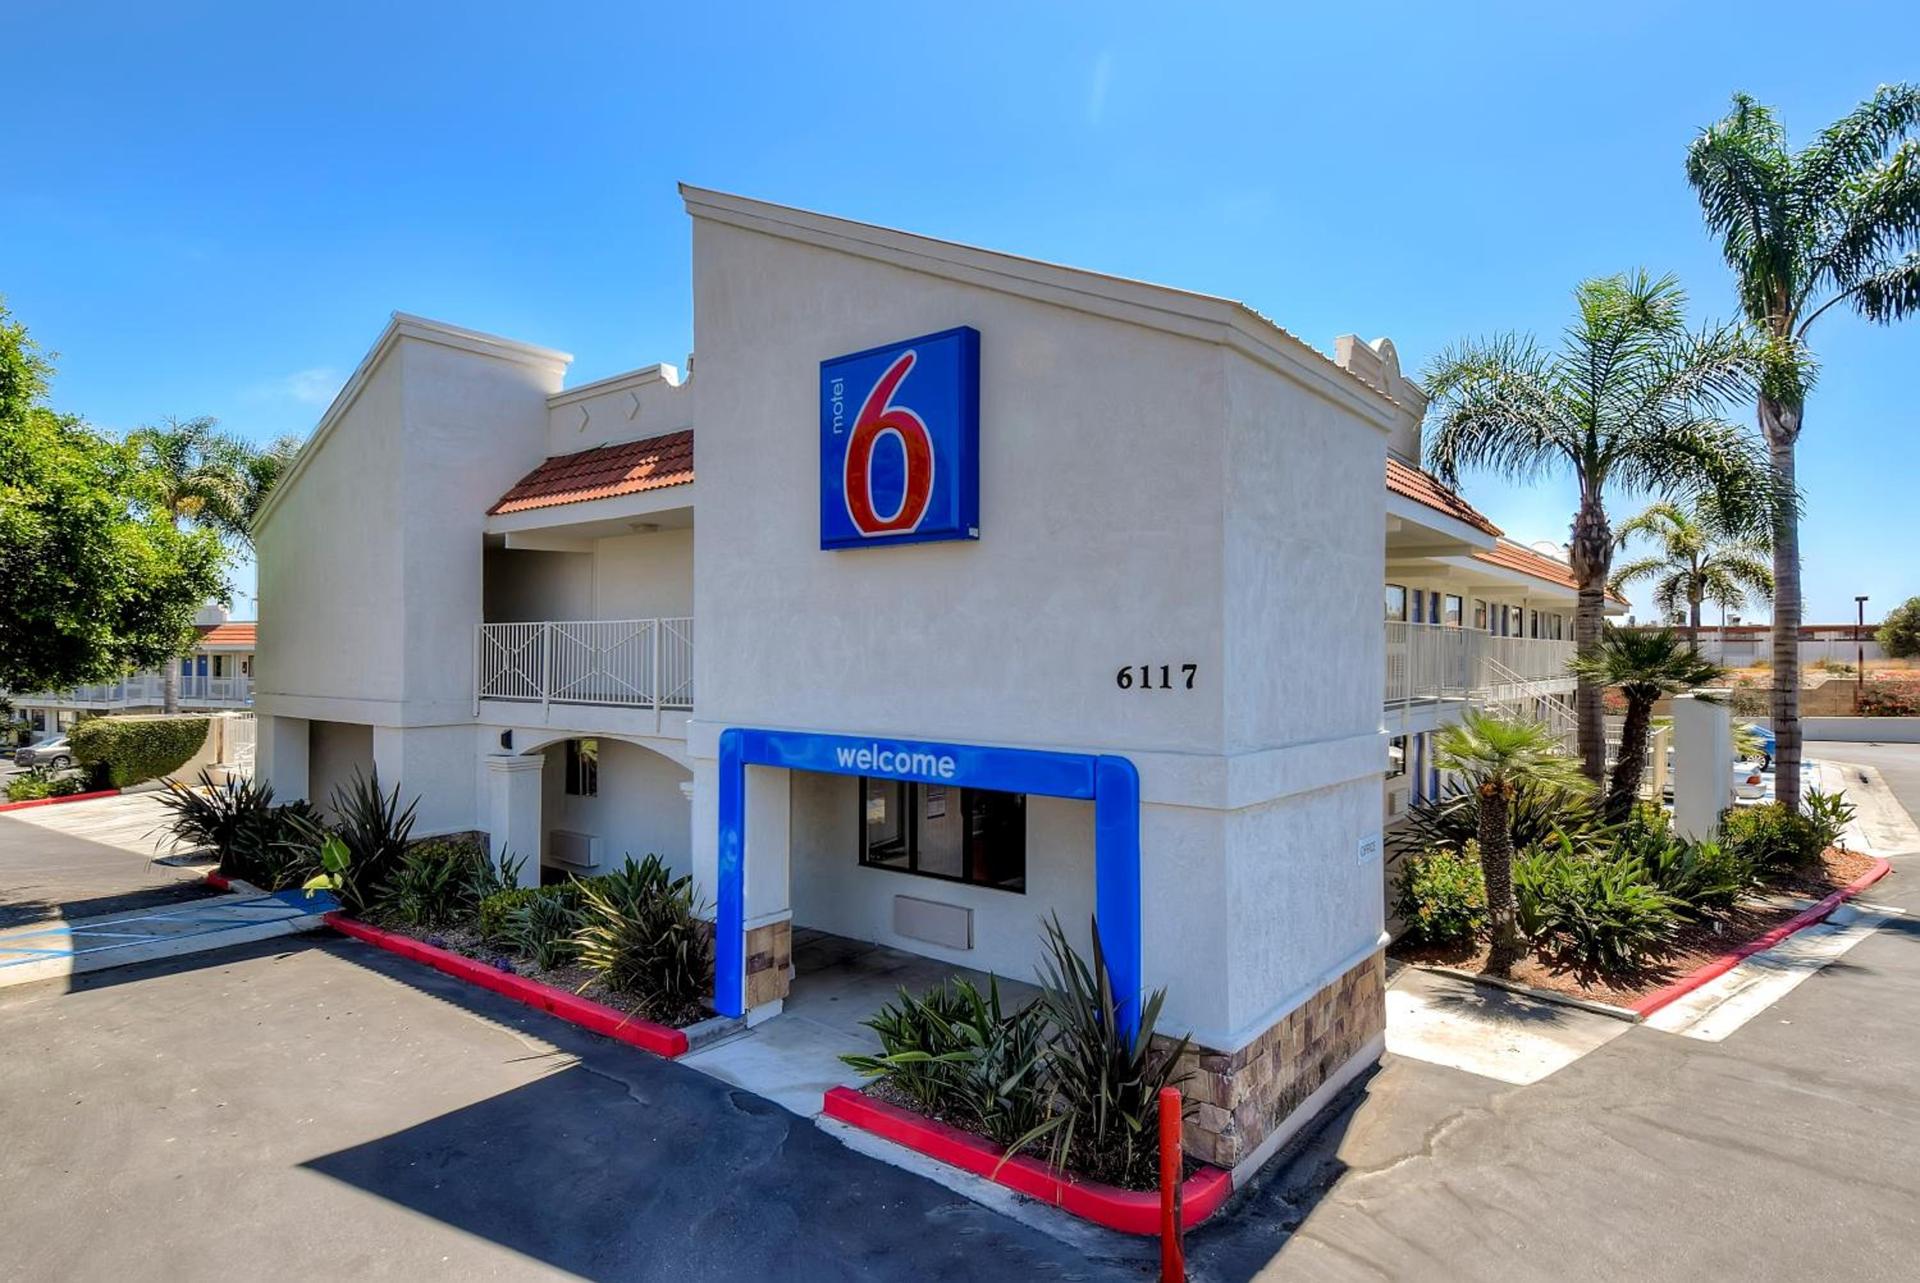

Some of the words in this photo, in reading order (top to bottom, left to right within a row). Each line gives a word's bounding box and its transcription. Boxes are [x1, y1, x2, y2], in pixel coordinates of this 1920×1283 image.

[830, 377, 844, 434] motel
[843, 350, 935, 537] 6
[1116, 663, 1198, 690] 6117
[836, 743, 956, 778] welcome
